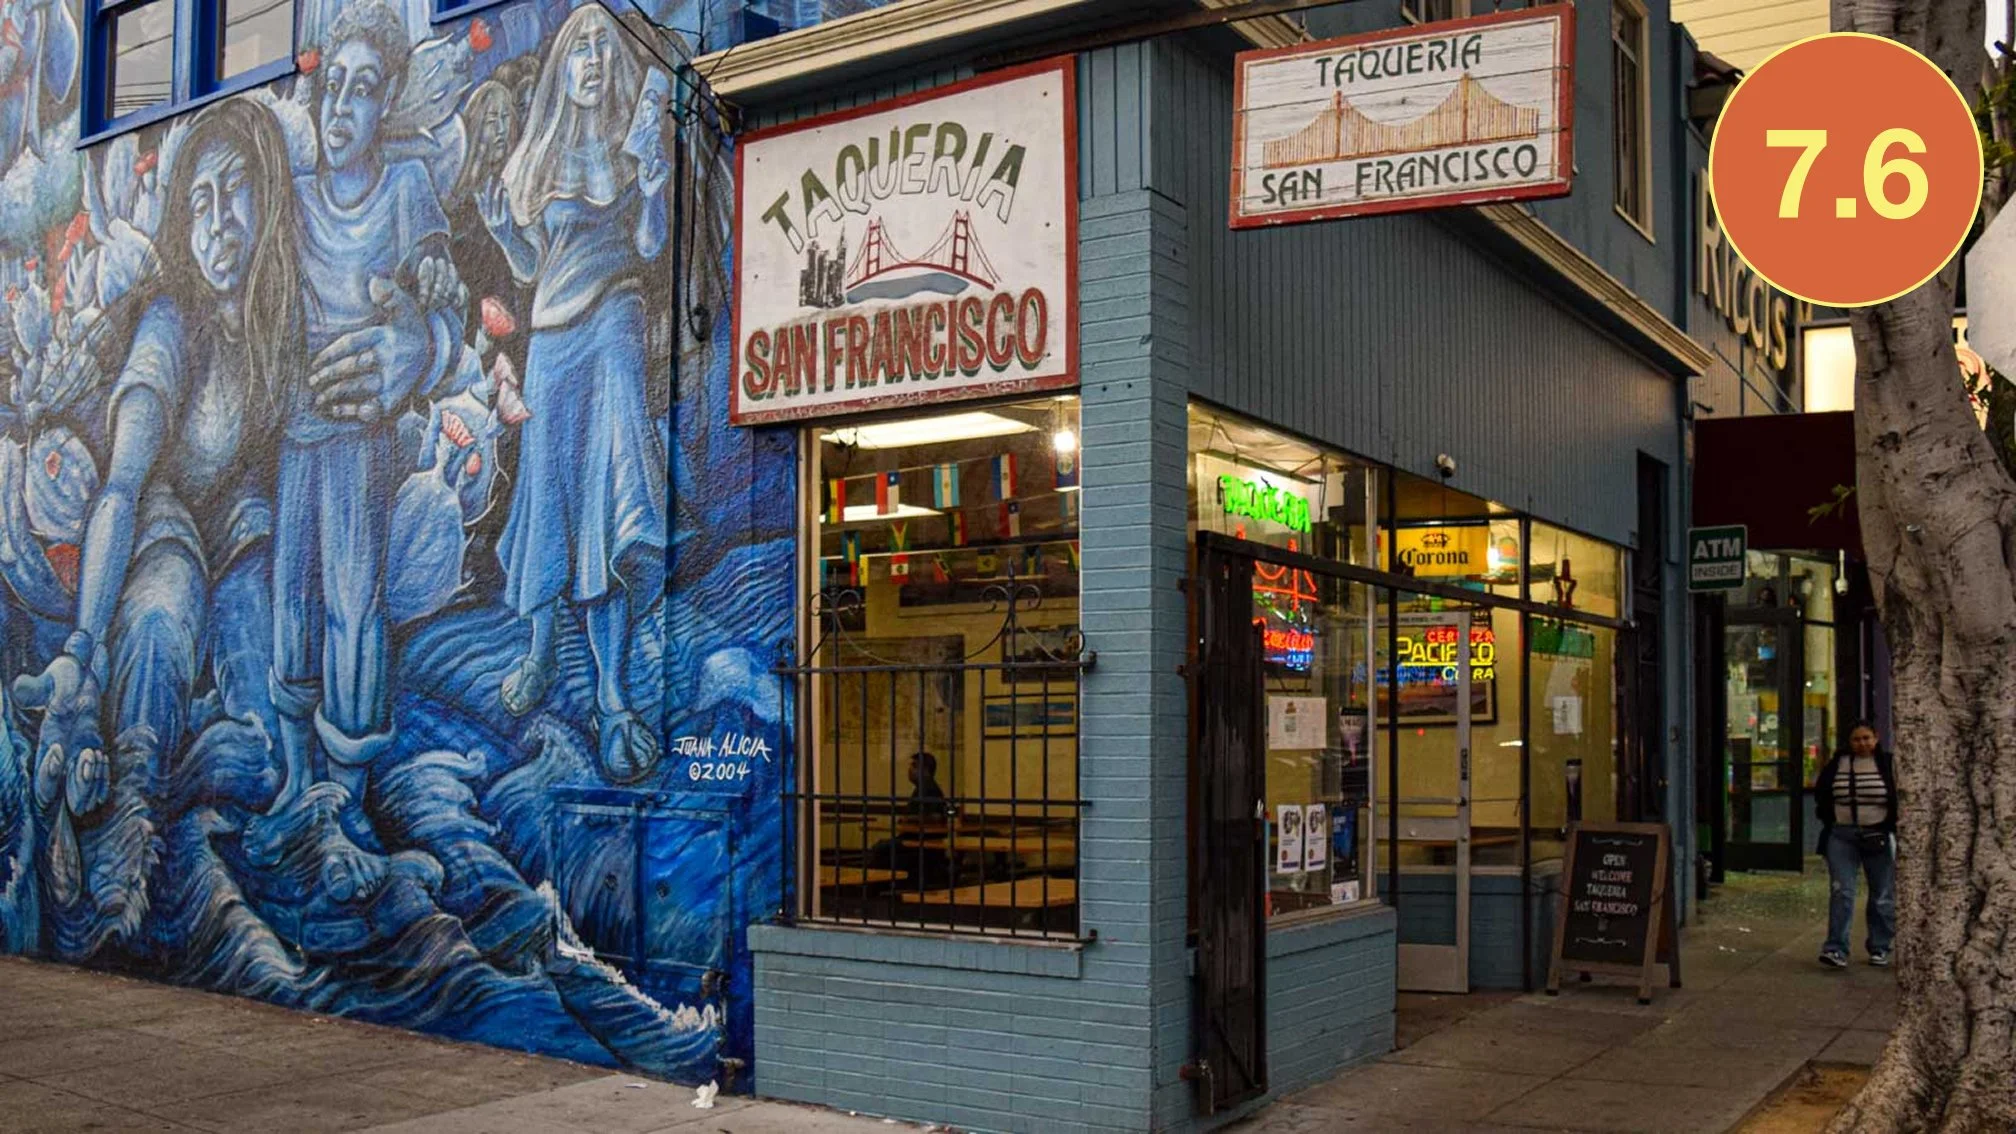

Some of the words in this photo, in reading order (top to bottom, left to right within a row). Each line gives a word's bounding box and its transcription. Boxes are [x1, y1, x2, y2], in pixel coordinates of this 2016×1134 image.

[1315, 34, 1482, 87] TAQUERIA
[1262, 168, 1322, 206] SAN
[1355, 144, 1538, 195] FRANCISCO
[761, 121, 1026, 254] TAQUERIA
[742, 322, 818, 401] SAN
[822, 287, 1049, 391] FRANCISCO
[1398, 547, 1469, 568] Corona
[1693, 537, 1741, 559] ATM
[1694, 564, 1738, 577] INSIDE
[1427, 631, 1495, 643] CERZA
[1396, 637, 1494, 663] PACIFO
[1442, 666, 1494, 681] CRA
[671, 736, 718, 758] JUANA
[718, 731, 772, 763] ALICIA
[1602, 853, 1627, 866] OPEN
[1591, 869, 1633, 883] WELCOME
[1586, 883, 1627, 898] TAQUERIA
[1573, 899, 1592, 912] SAN
[1591, 900, 1638, 917] FRANCISCO
